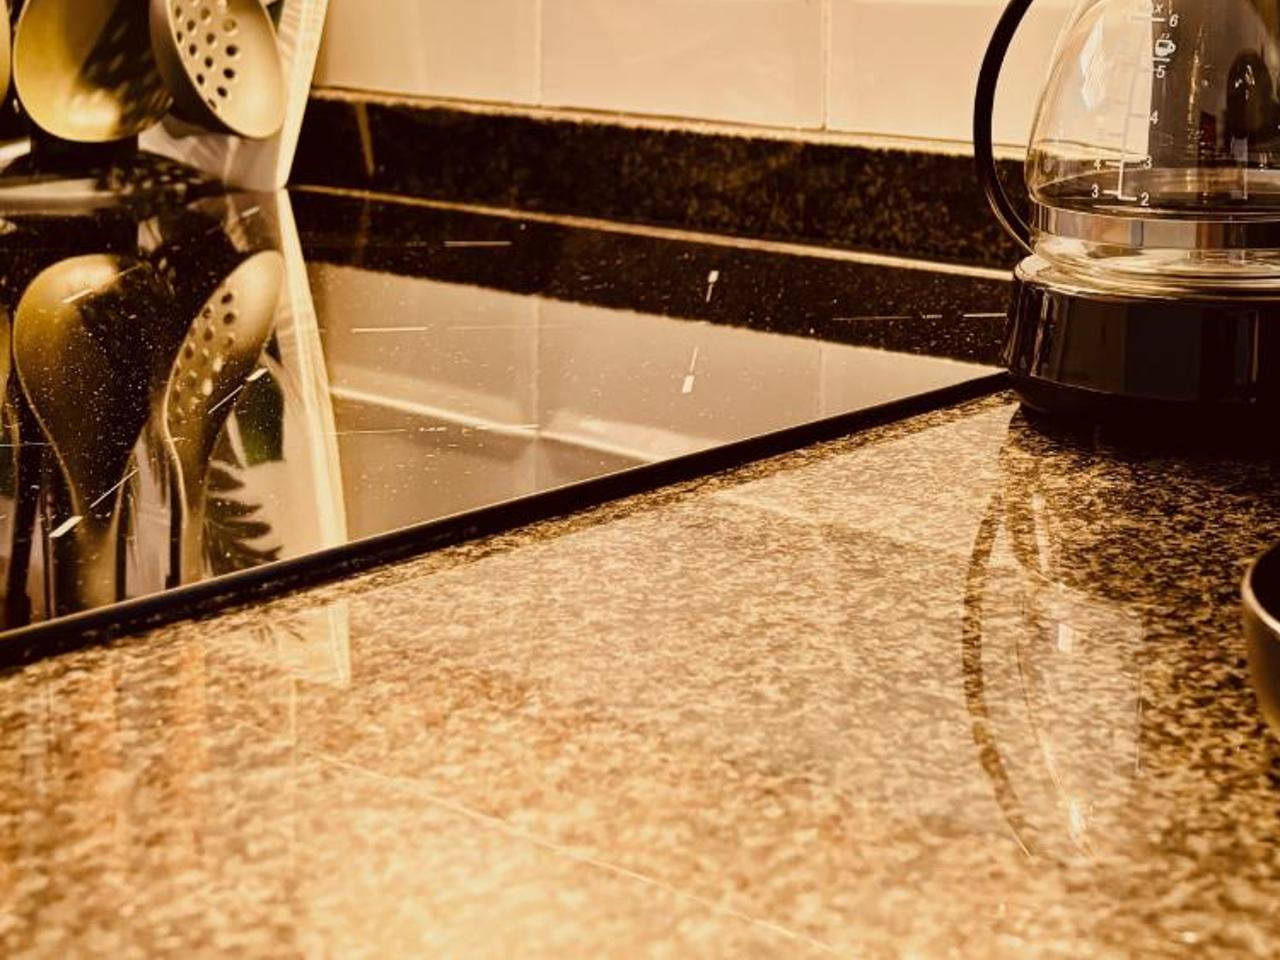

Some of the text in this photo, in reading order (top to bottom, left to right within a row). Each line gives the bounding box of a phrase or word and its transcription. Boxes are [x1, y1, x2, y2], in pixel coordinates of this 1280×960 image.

[1169, 14, 1179, 27] 6
[1156, 65, 1166, 78] 5
[1091, 183, 1099, 198] 3
[1140, 192, 1150, 206] 2
